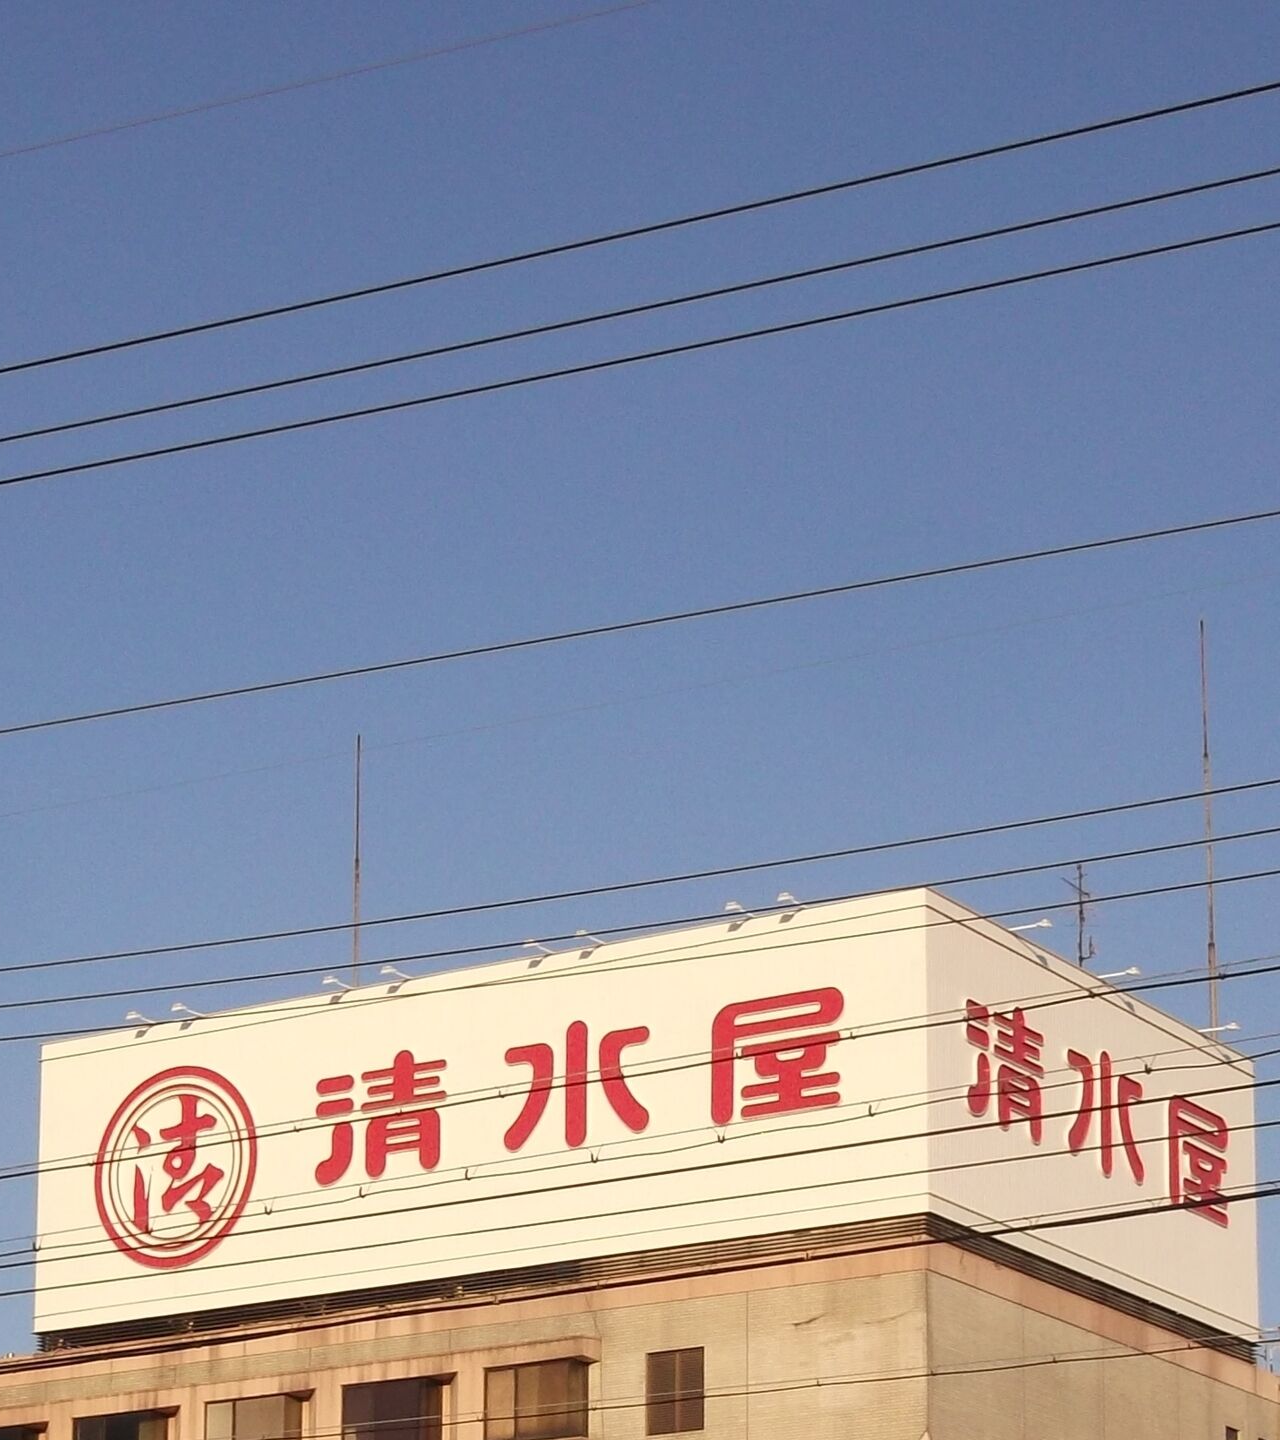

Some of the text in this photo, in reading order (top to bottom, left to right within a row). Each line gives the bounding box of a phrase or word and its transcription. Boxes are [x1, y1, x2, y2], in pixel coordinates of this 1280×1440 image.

[315, 987, 844, 1186] 清水屋
[966, 1000, 1229, 1227] 清水屋
